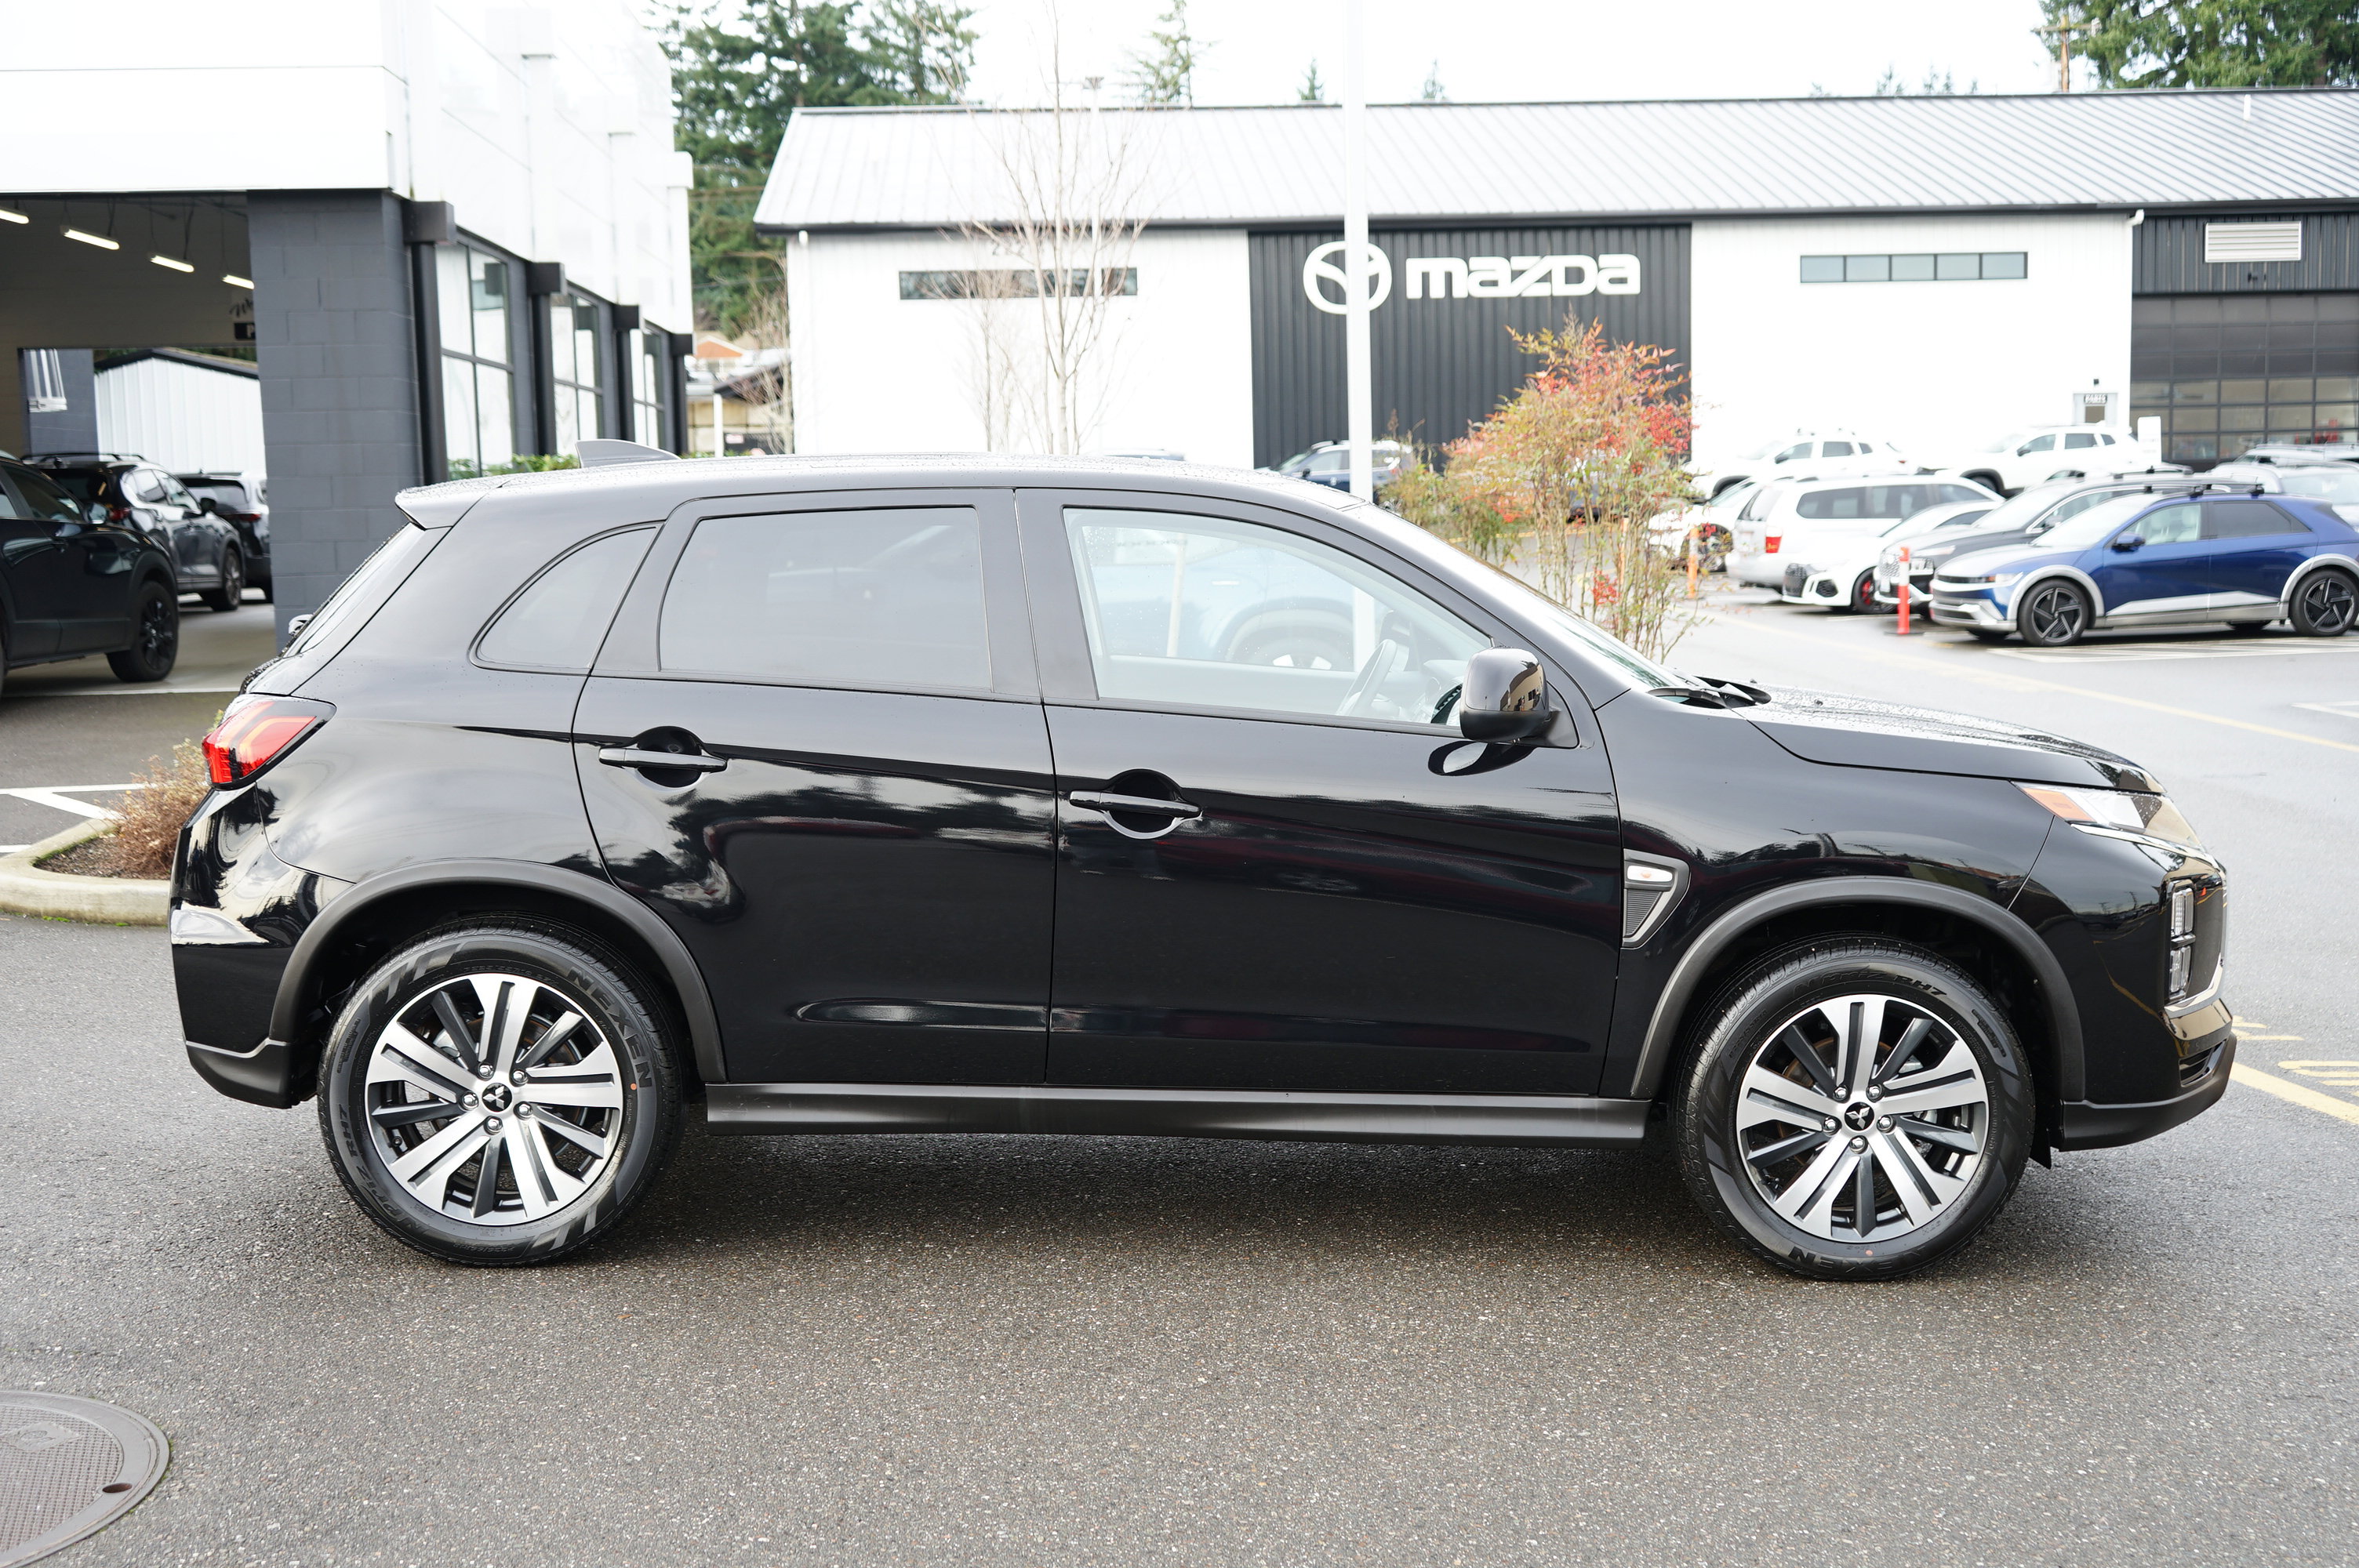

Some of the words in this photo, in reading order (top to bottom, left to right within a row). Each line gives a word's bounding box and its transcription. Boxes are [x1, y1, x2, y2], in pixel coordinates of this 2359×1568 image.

[1894, 975, 1947, 996] RH7
[567, 967, 652, 1088] NEXEN
[339, 1104, 358, 1157] RH7
[1789, 1246, 1926, 1275] NEXEN
